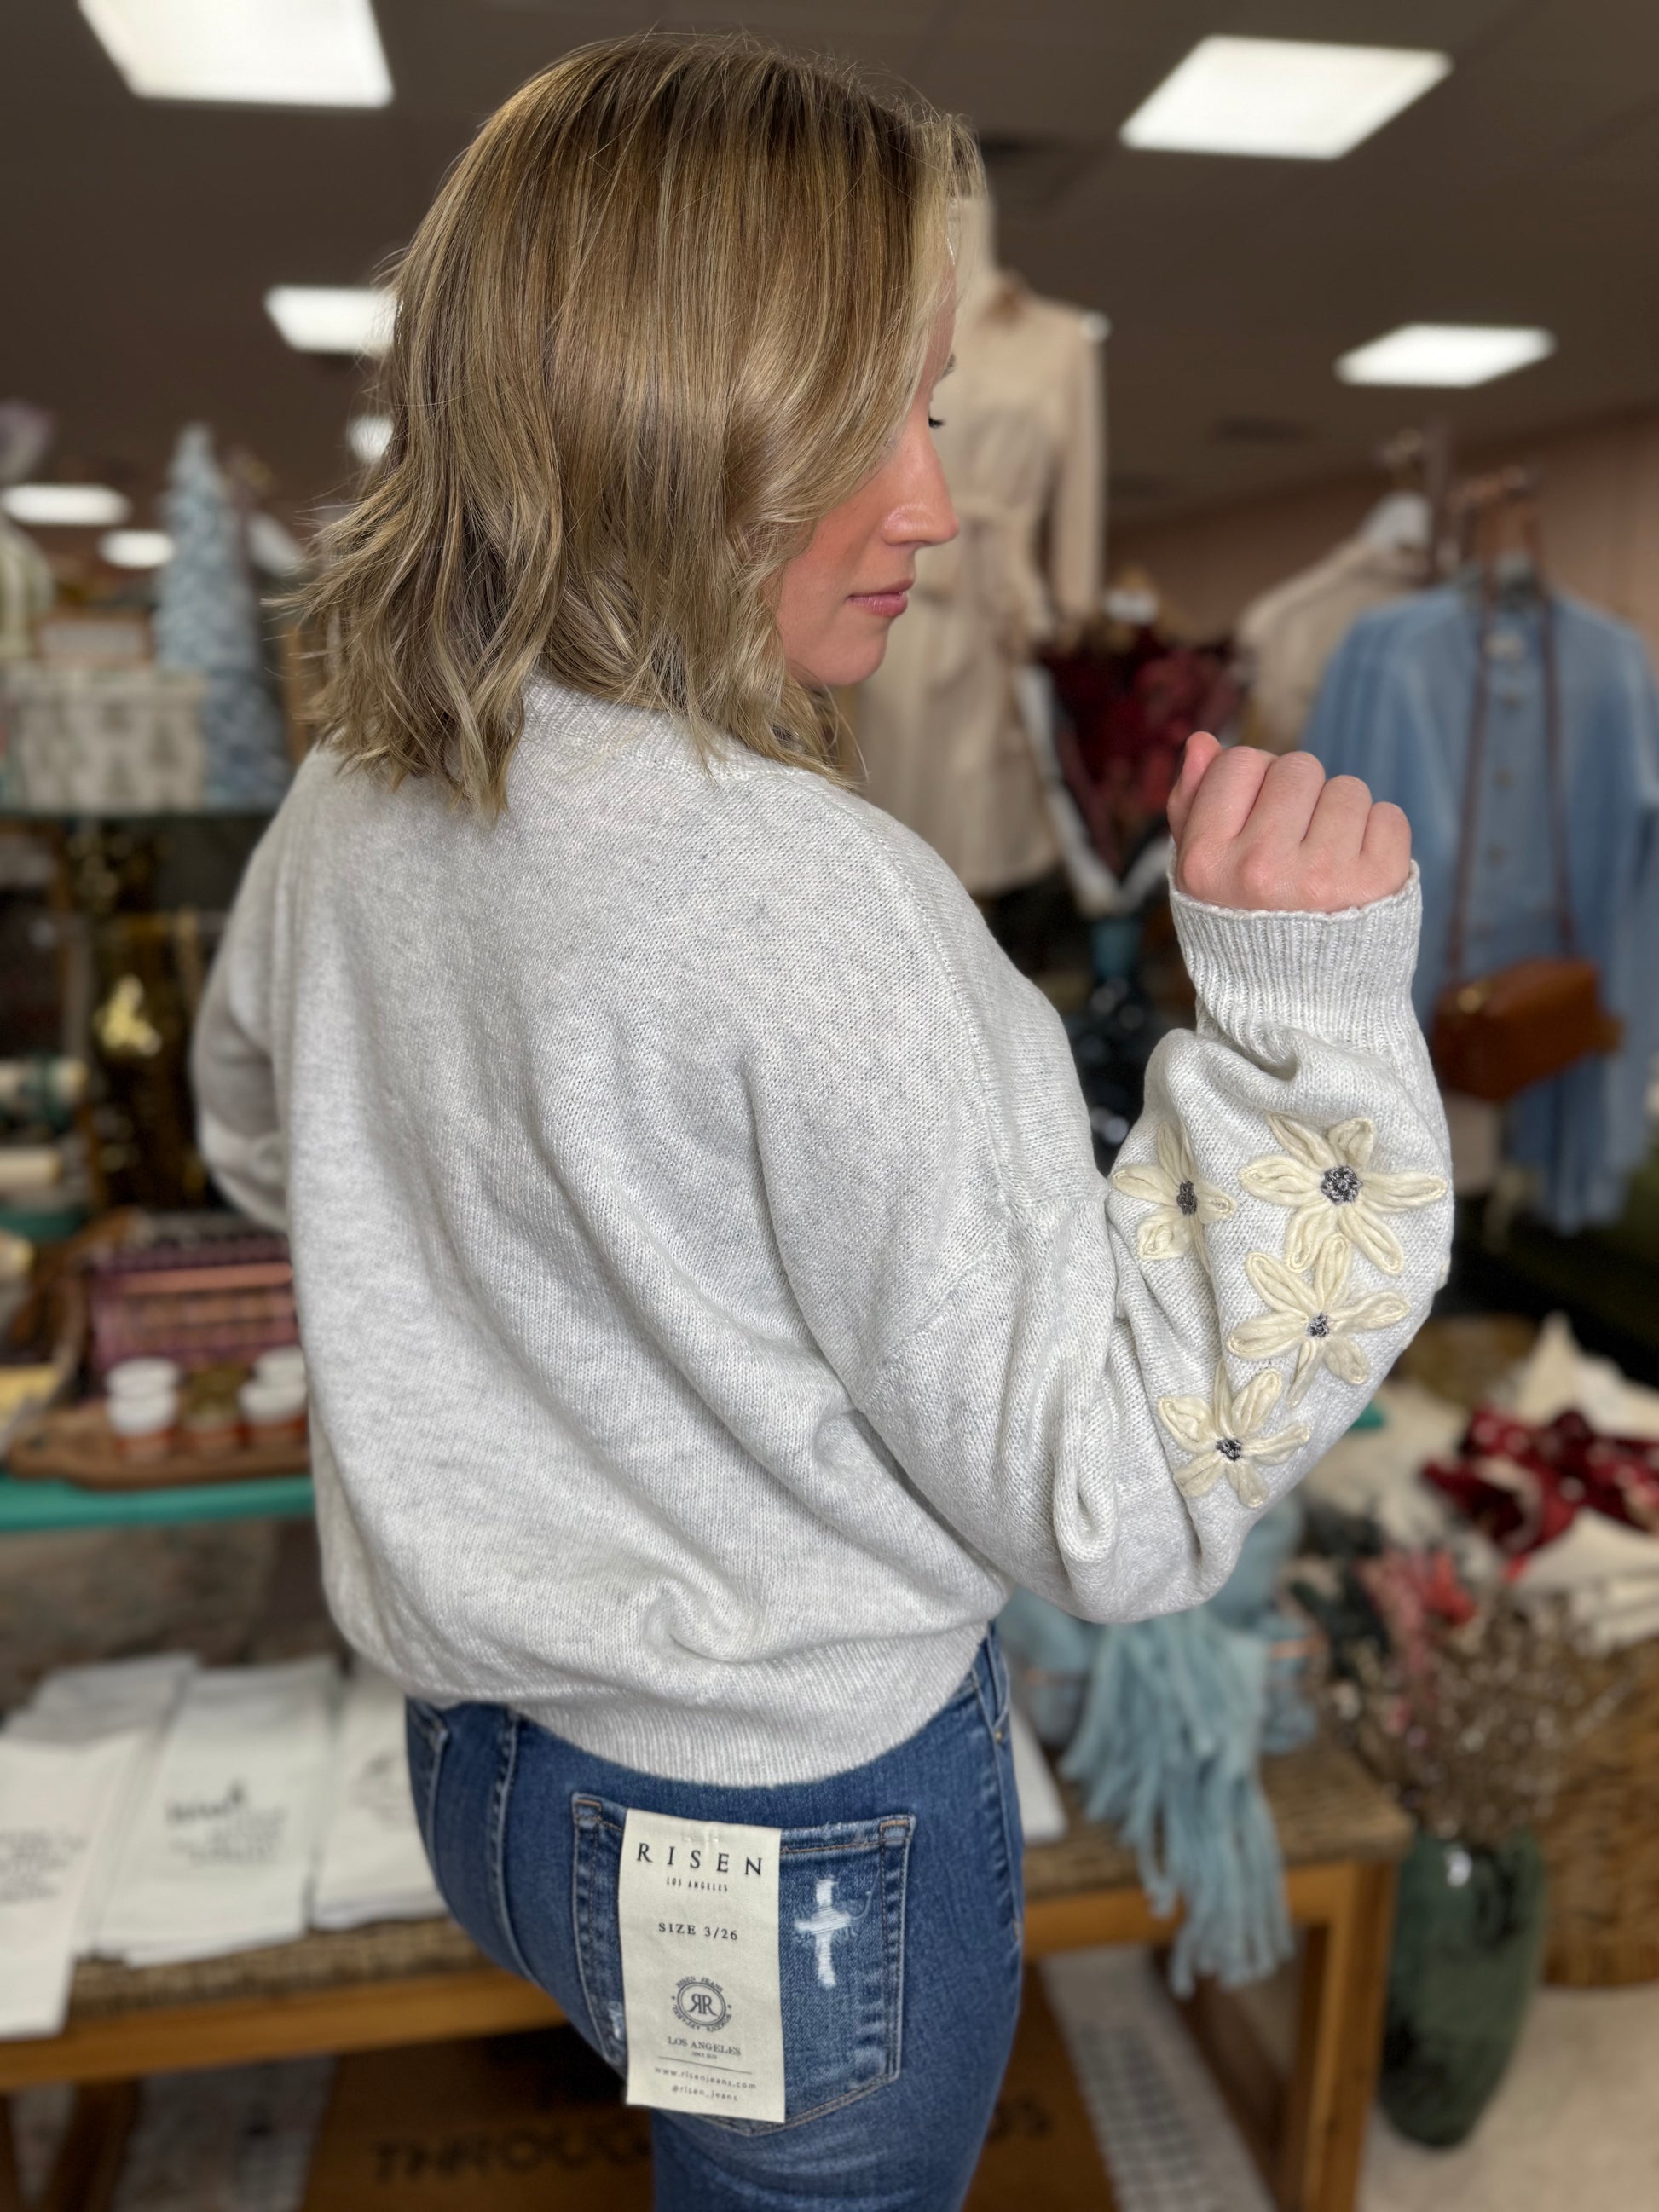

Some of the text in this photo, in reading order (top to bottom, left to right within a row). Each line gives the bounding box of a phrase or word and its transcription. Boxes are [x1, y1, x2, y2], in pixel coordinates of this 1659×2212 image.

[637, 1842, 763, 1876] RISEN
[666, 1877, 728, 1892] LOS ANGELES
[658, 1922, 738, 1941] SIZE 3/26
[668, 2036, 688, 2047] LOS
[691, 2040, 742, 2057] ANGELES
[654, 2066, 757, 2089] www.risenjeans.com
[672, 2084, 738, 2102] @risen_jeans
